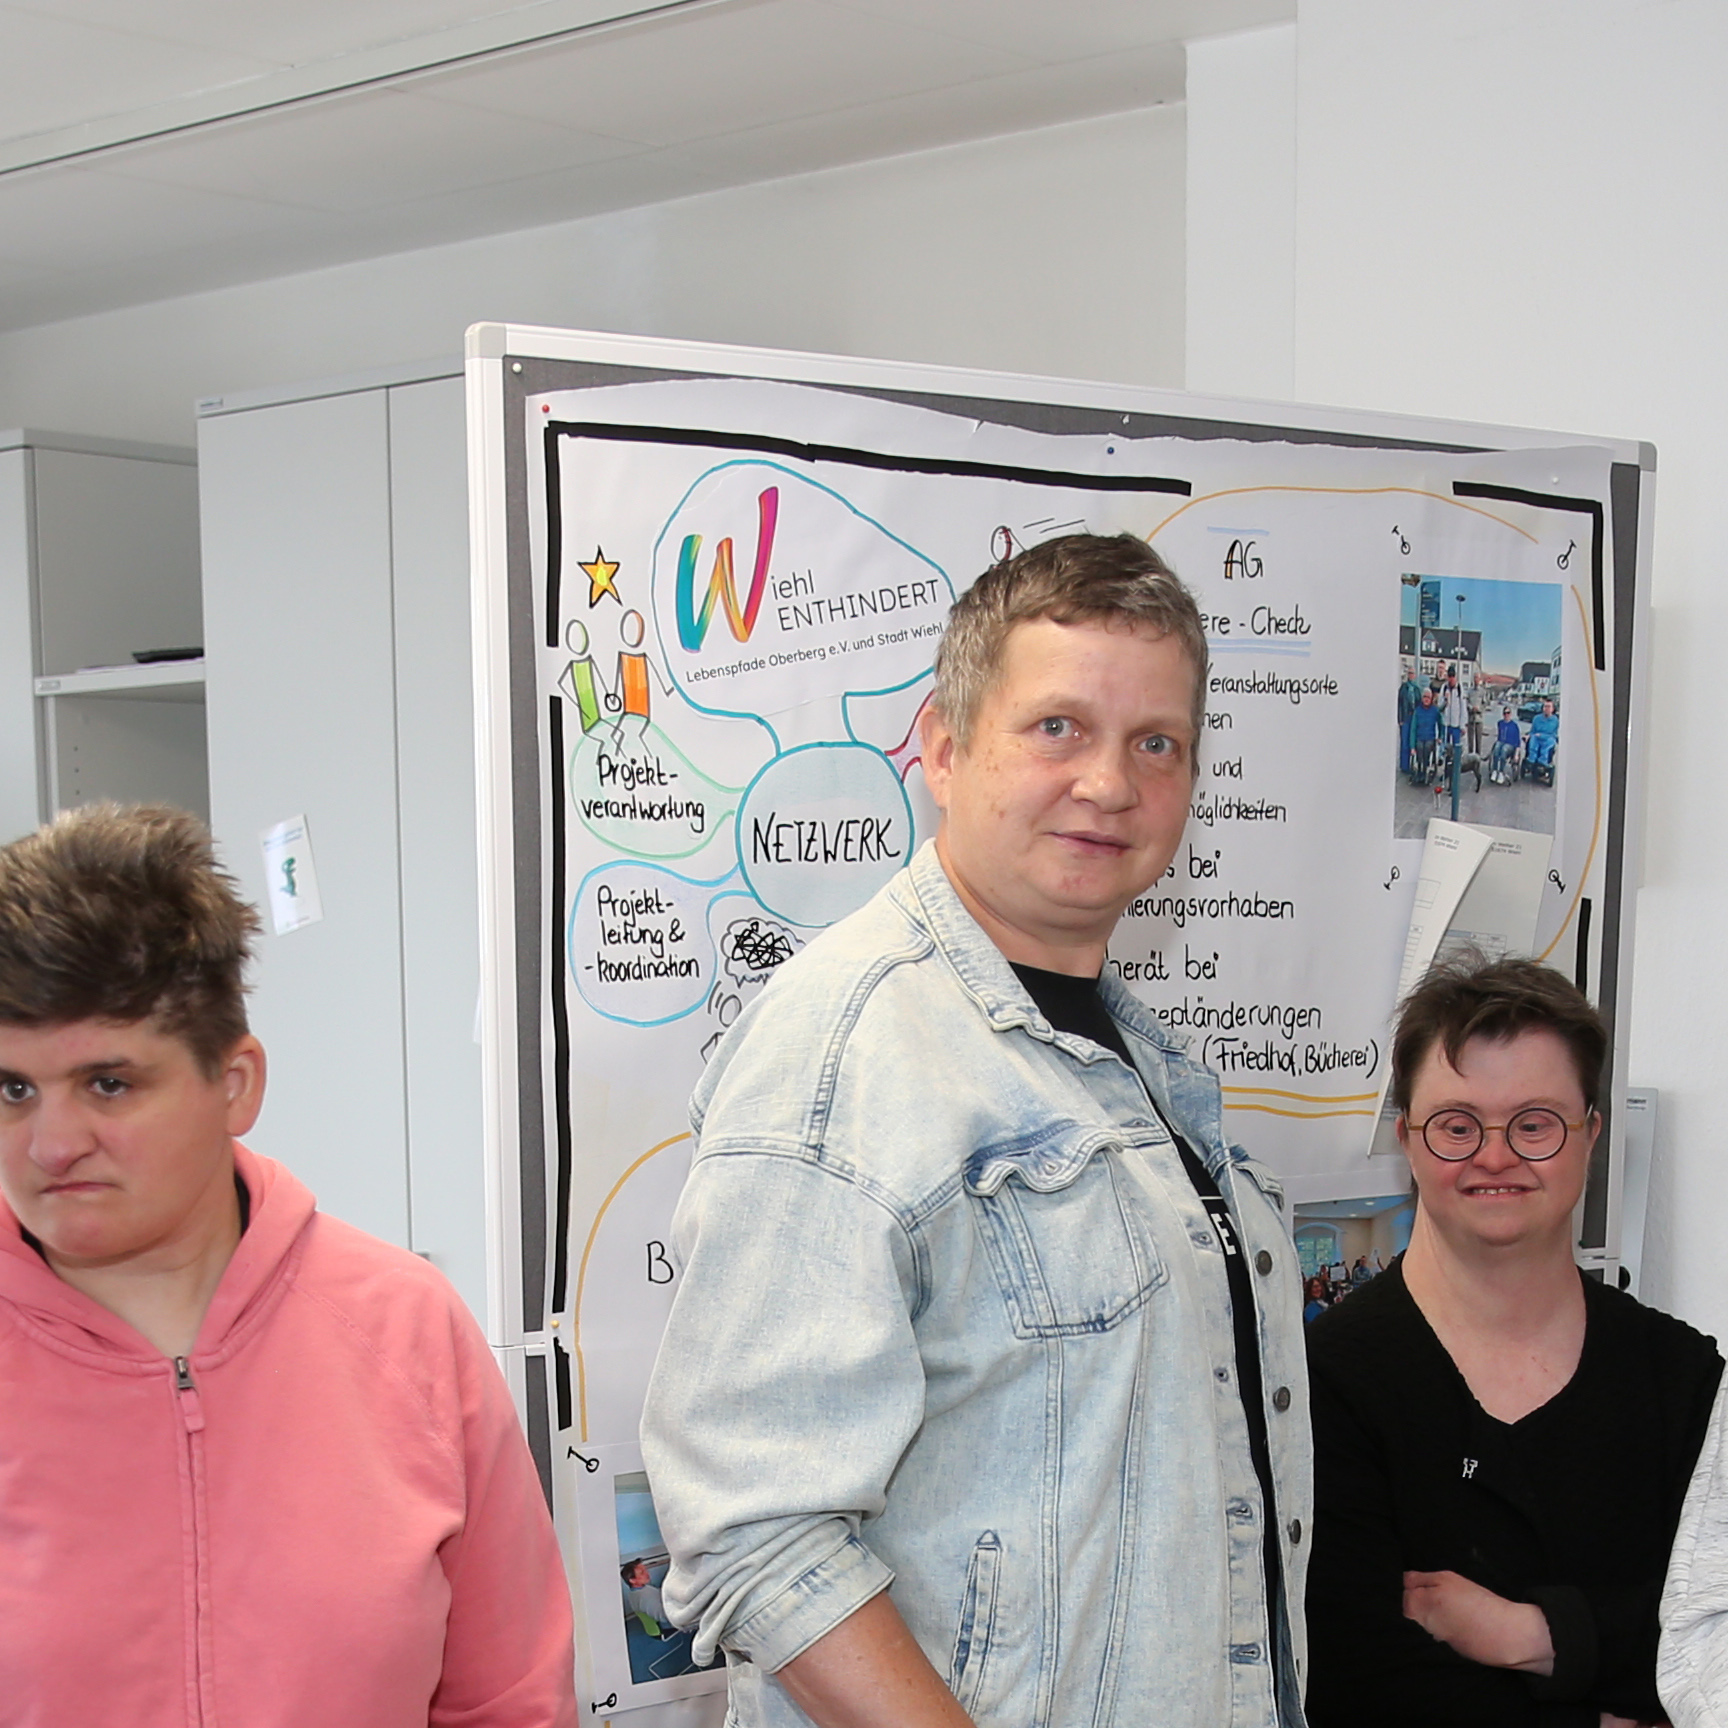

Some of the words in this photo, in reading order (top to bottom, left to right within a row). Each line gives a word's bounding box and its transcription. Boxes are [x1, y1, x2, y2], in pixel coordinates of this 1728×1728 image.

[1223, 538, 1264, 580] AG
[777, 578, 940, 632] ENTHINDERT
[1199, 612, 1231, 635] ere
[1251, 603, 1311, 636] Check
[686, 657, 767, 683] Lebenspfade
[768, 645, 826, 667] Oberberg
[852, 635, 875, 651] und
[877, 629, 909, 646] Stadt
[910, 621, 944, 640] Wiehl
[1206, 662, 1339, 705] eranstaltungsorte
[597, 753, 679, 792] Projekt-
[1212, 756, 1243, 780] und
[580, 794, 705, 834] verantwortung
[753, 811, 901, 865] NETZWERK
[1189, 843, 1221, 879] bei
[597, 884, 675, 928] Projekt-
[1121, 890, 1295, 929] ierungsvorhaben
[1184, 943, 1220, 981] bei
[1149, 997, 1322, 1040] eptänderungen
